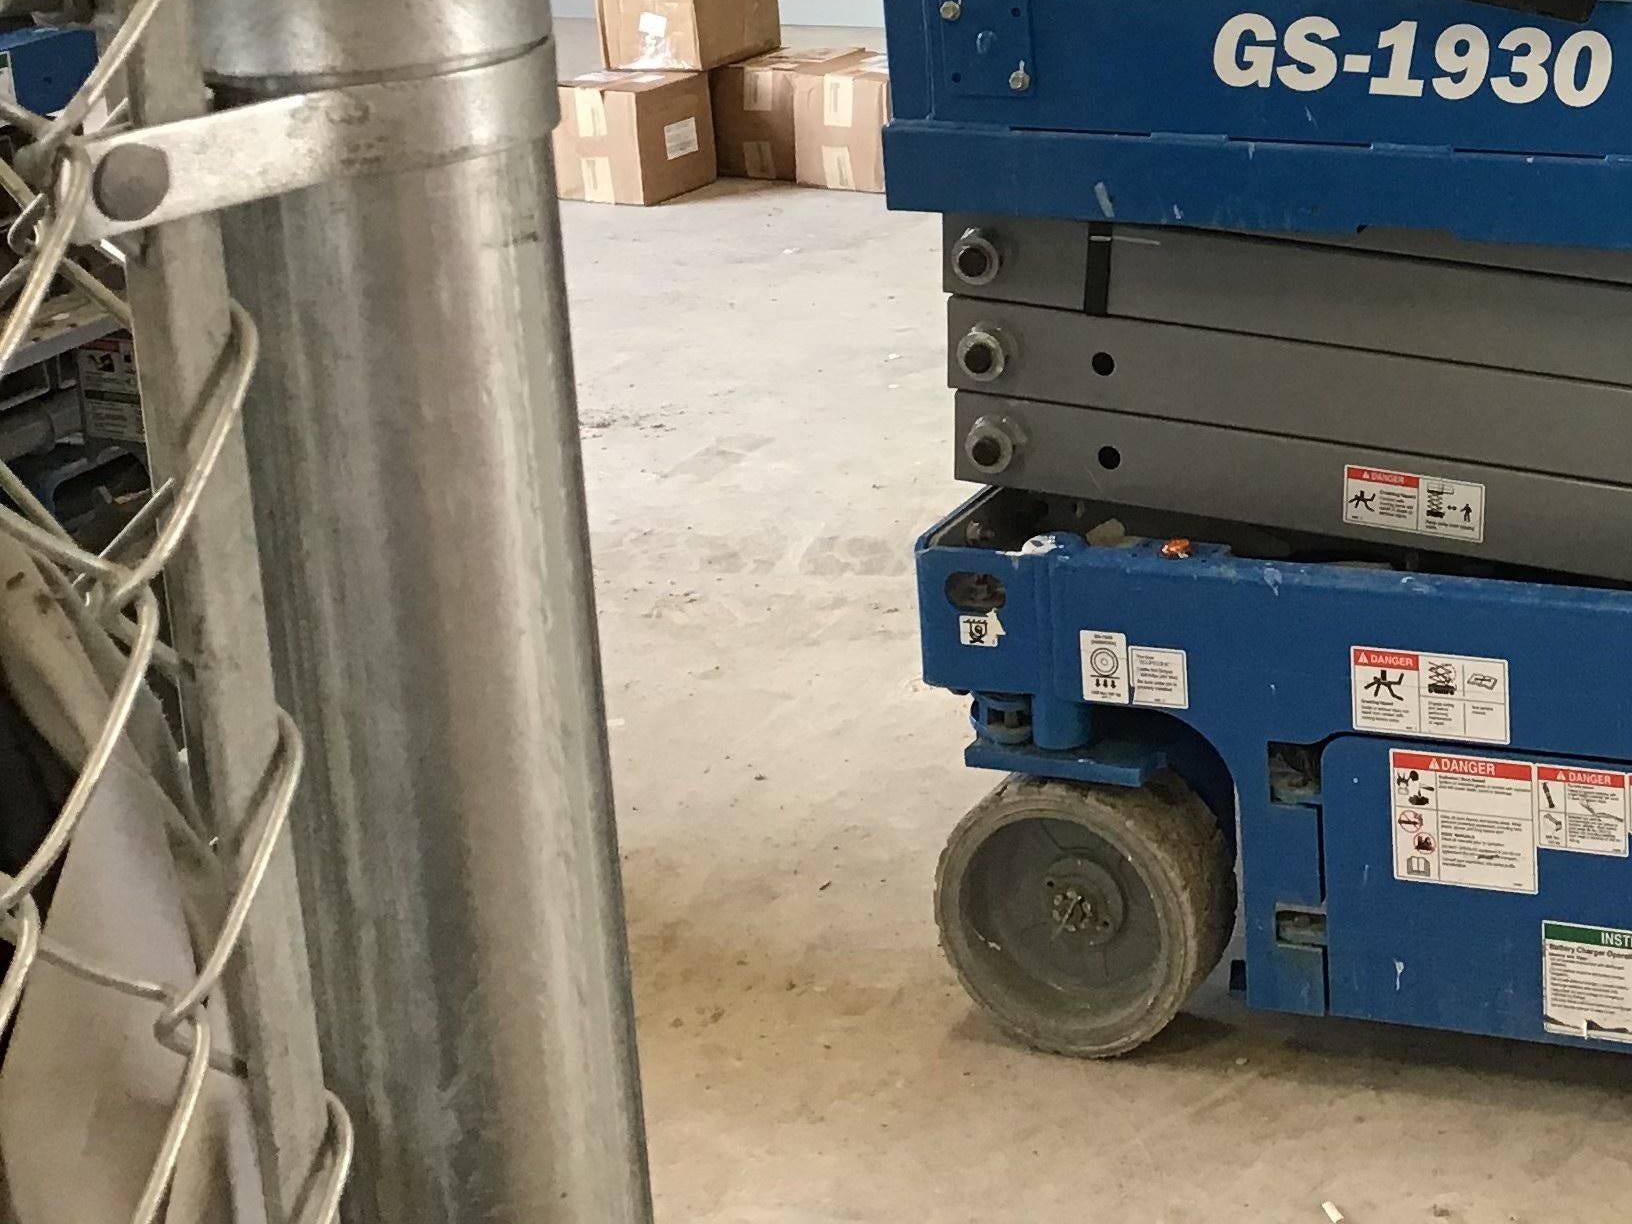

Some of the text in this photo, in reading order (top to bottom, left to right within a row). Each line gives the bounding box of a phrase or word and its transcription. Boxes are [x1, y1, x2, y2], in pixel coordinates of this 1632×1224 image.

[1212, 11, 1614, 110] GS-1930
[1371, 472, 1405, 484] DANGER
[1370, 655, 1413, 667] DANGER
[1441, 758, 1496, 776] DANGER
[1568, 773, 1612, 785] DANGER
